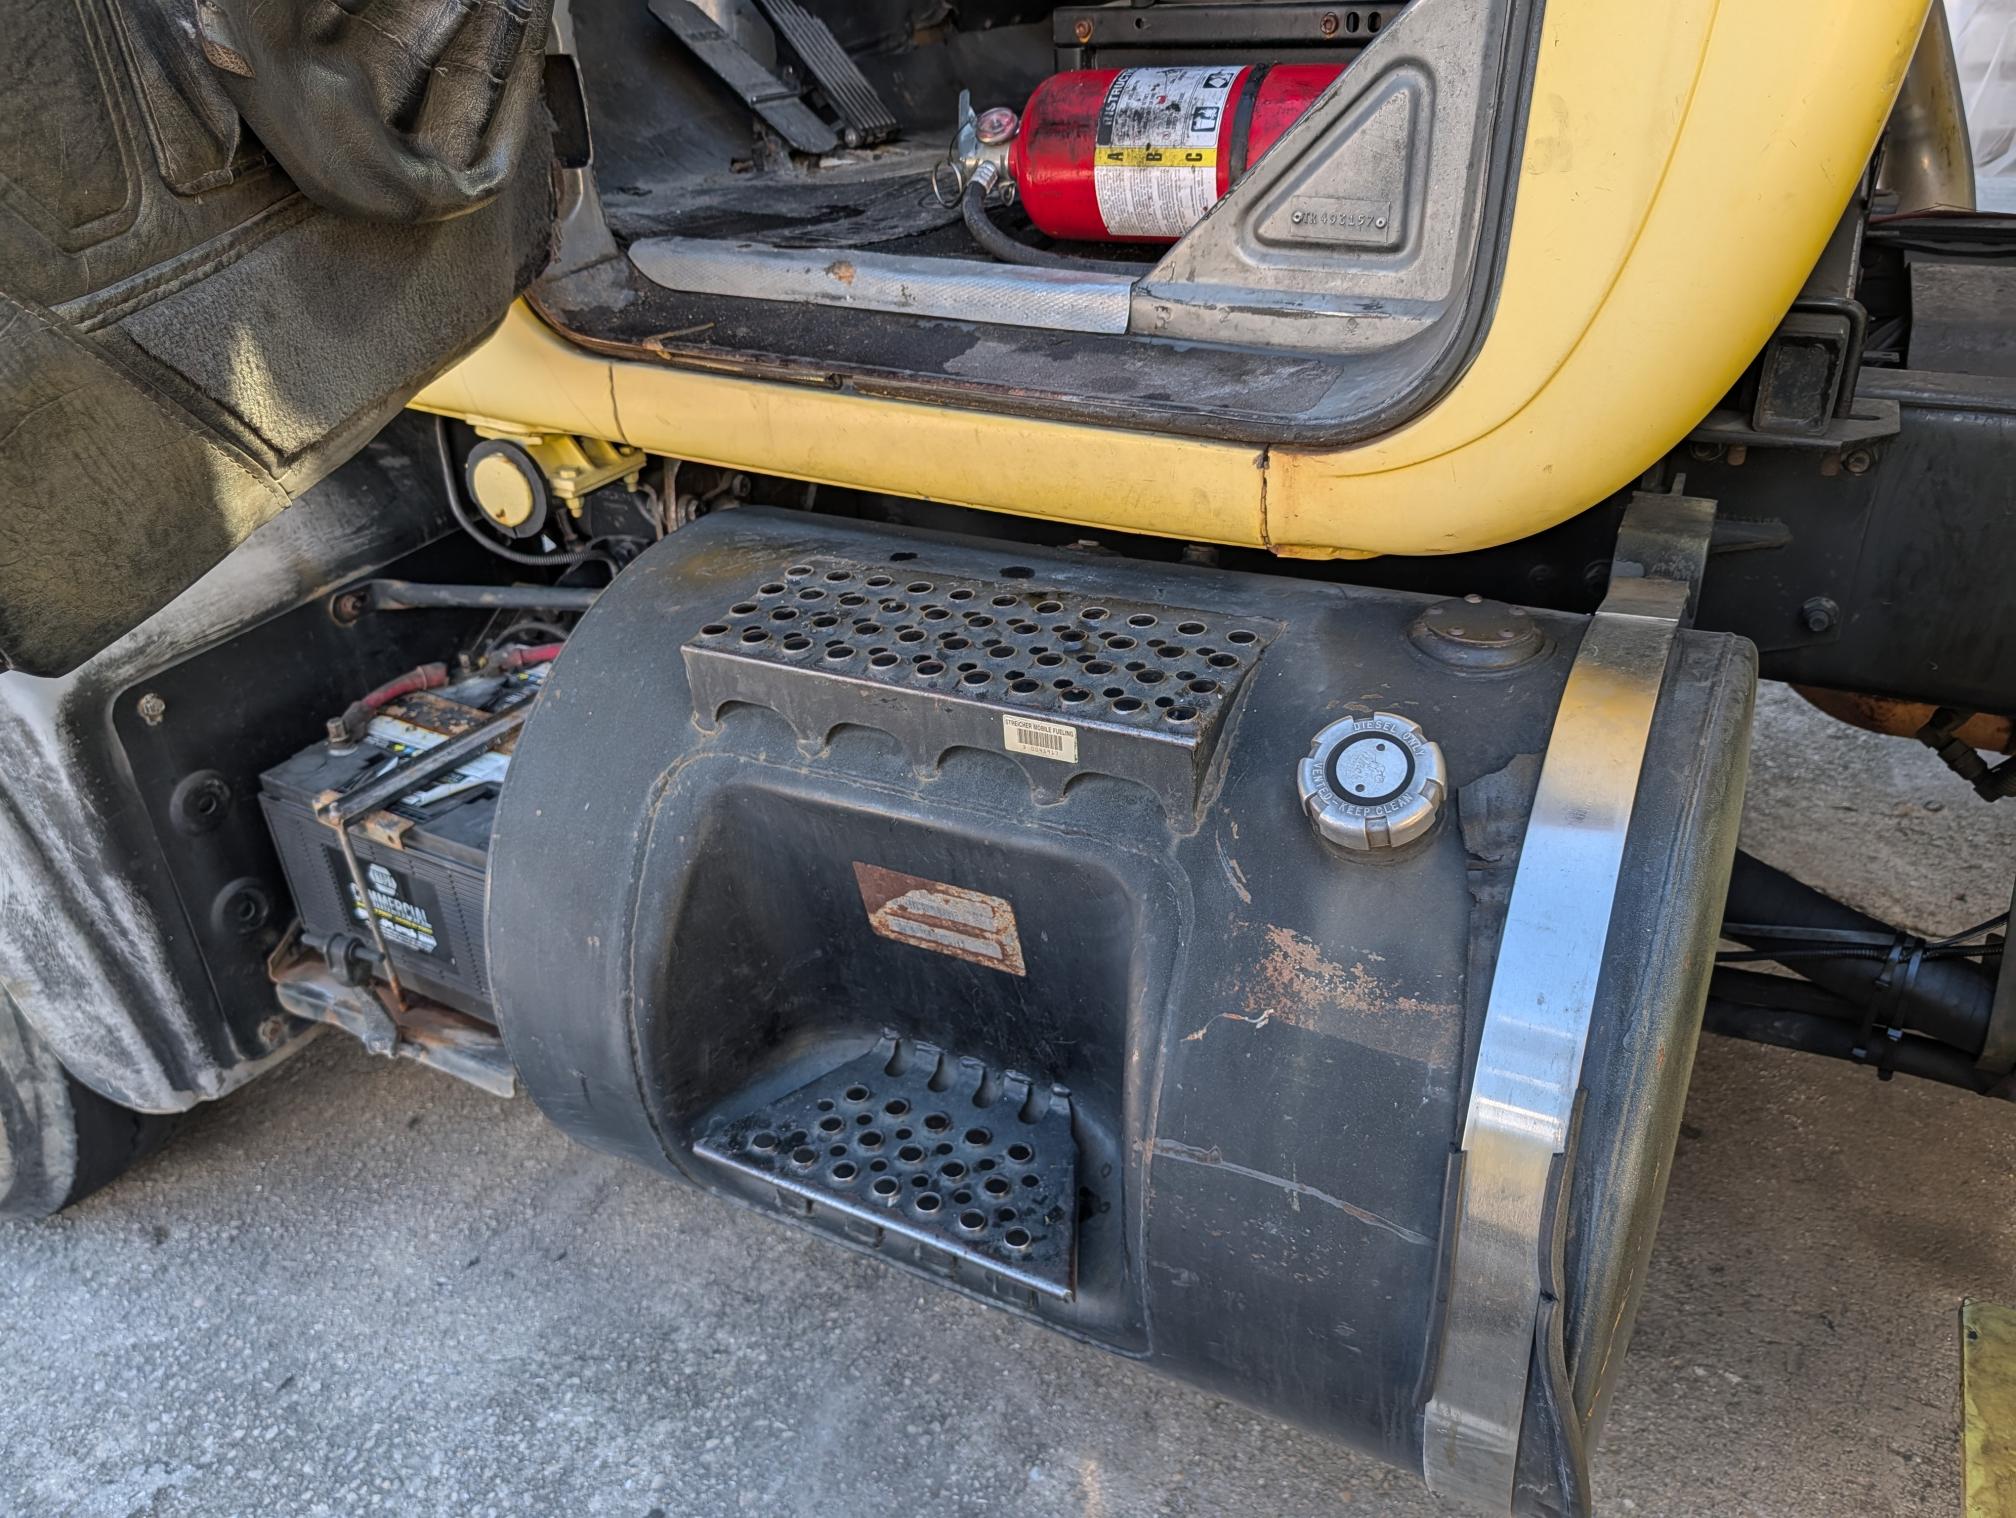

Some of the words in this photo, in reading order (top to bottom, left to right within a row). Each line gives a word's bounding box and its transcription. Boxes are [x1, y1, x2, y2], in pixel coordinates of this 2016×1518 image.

[1107, 151, 1124, 162] A
[1146, 152, 1163, 162] B
[1185, 152, 1203, 162] C
[1005, 719, 1032, 730] STREICHER
[1033, 724, 1052, 734] MOBILE
[1053, 727, 1074, 737] FUELING
[1353, 720, 1397, 734] DIESEL
[1402, 732, 1426, 757] ONLY
[1375, 792, 1414, 816] CLEAN
